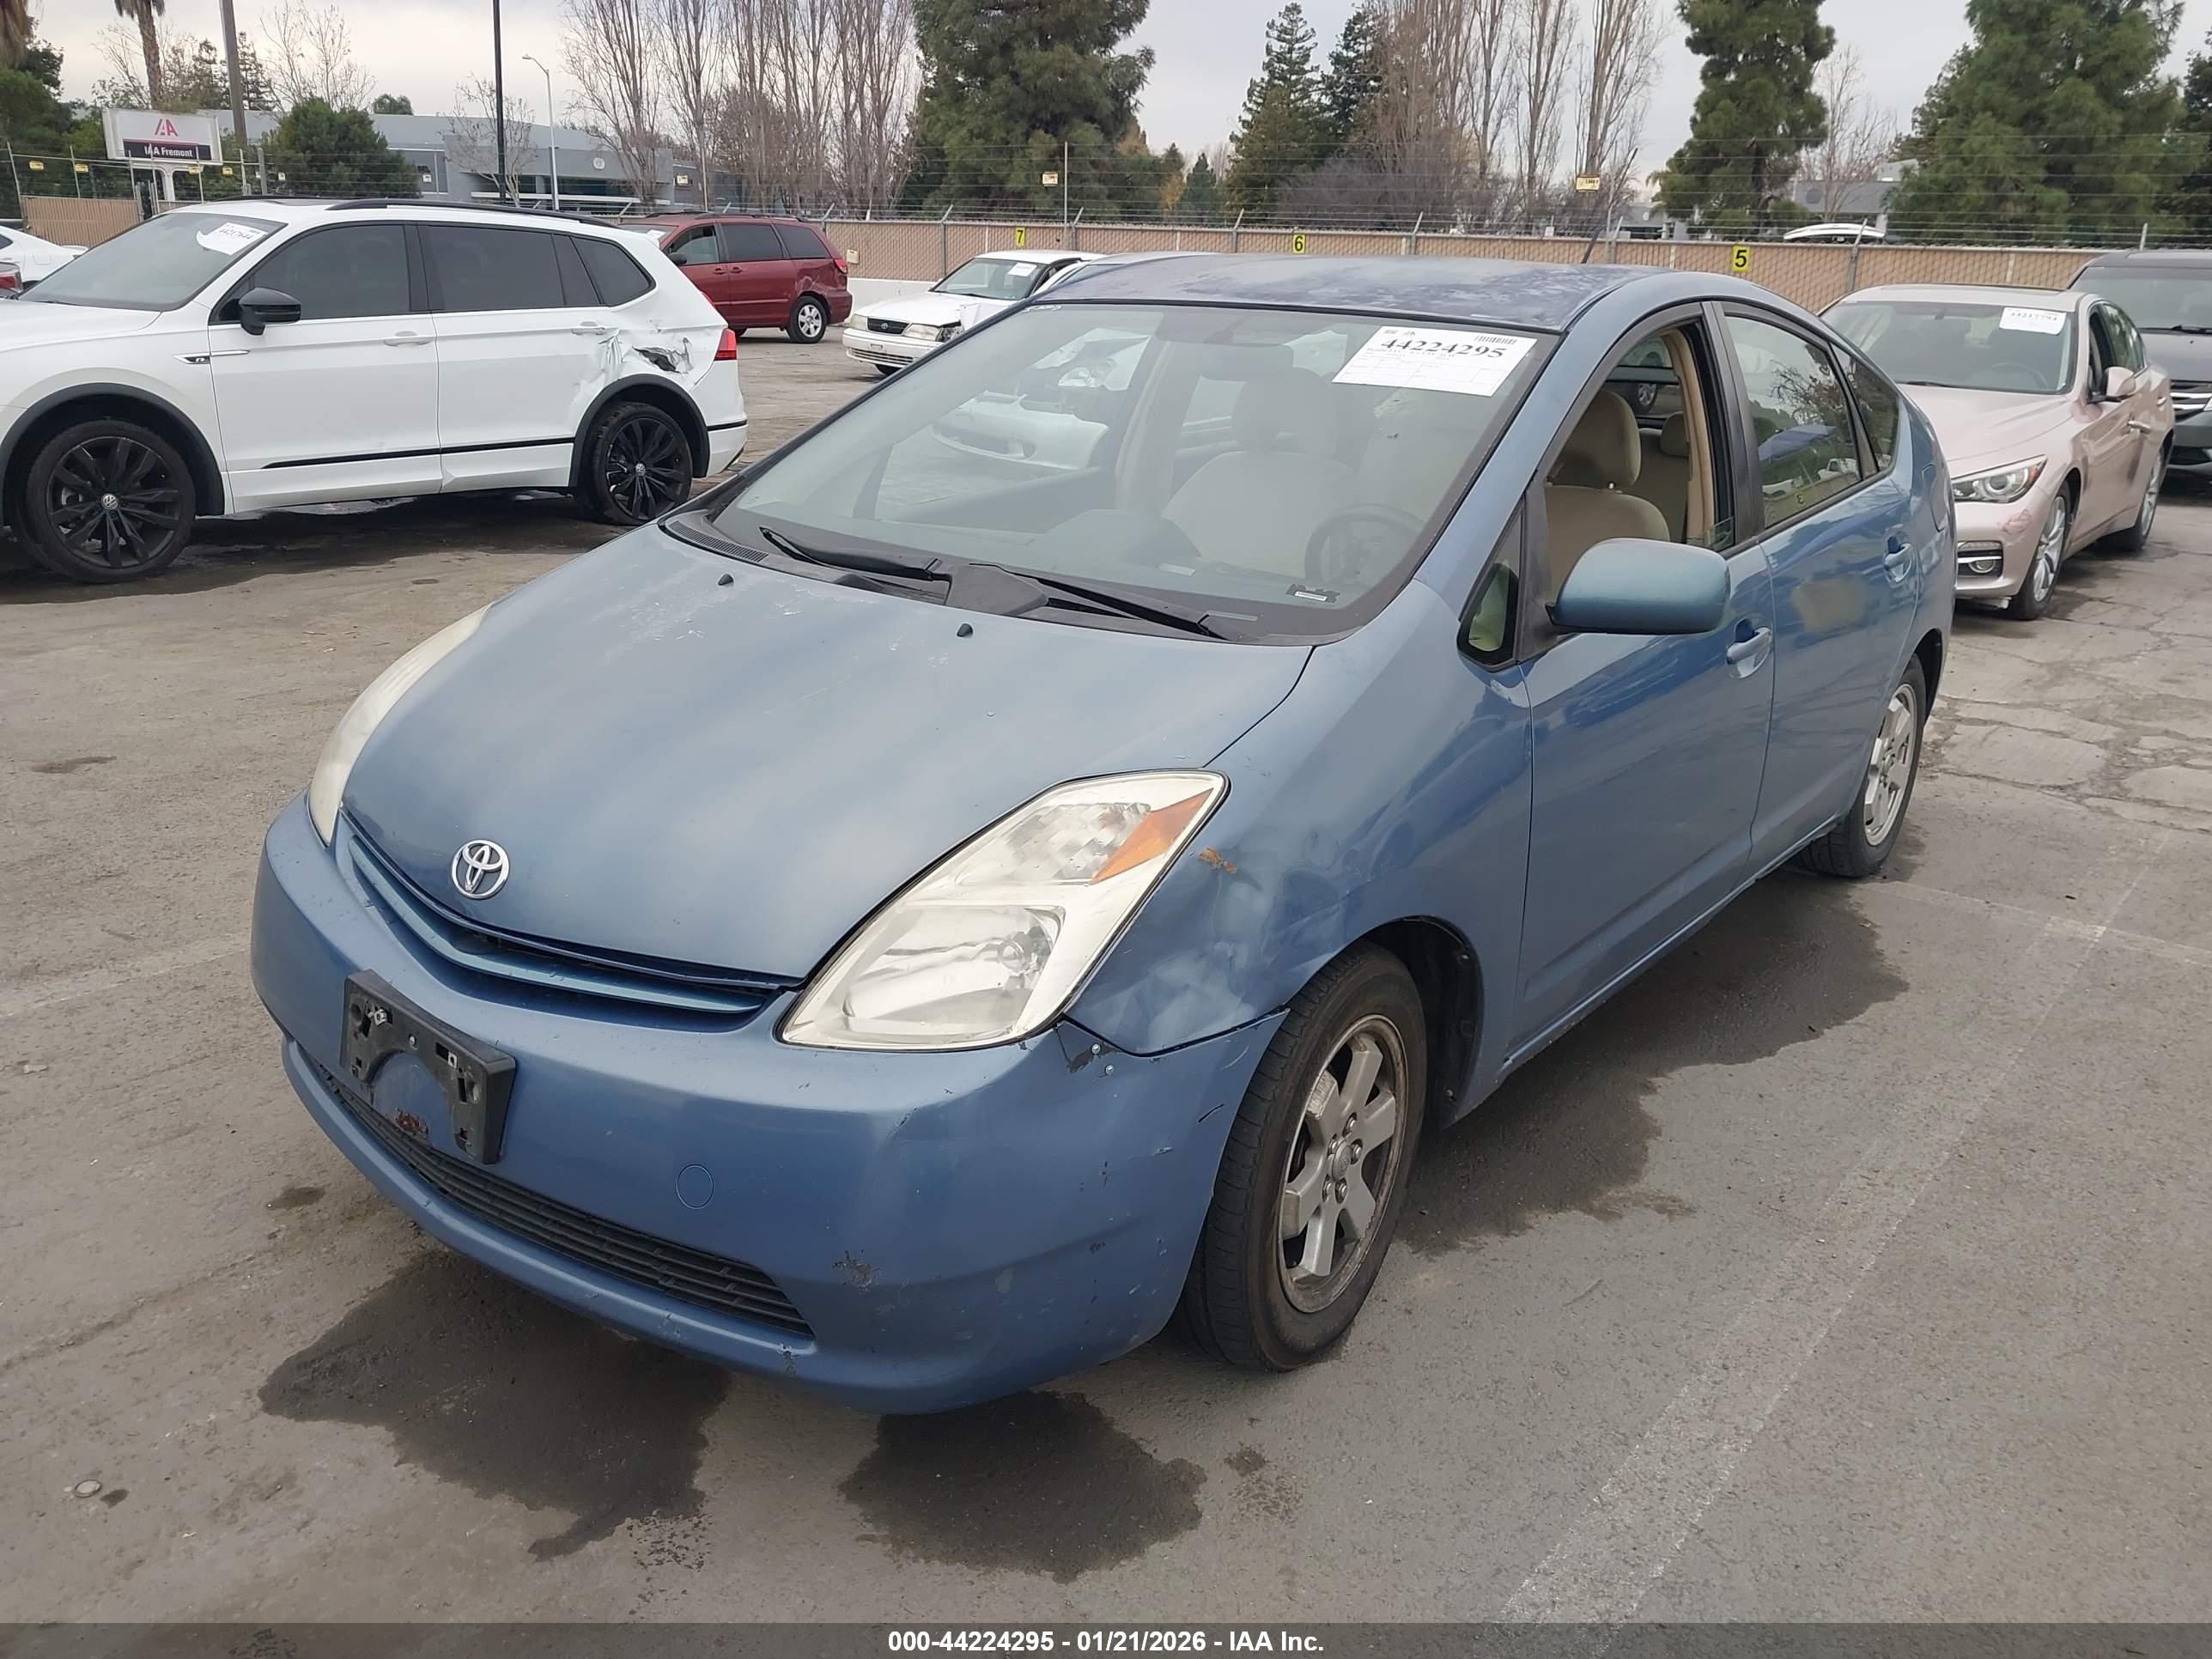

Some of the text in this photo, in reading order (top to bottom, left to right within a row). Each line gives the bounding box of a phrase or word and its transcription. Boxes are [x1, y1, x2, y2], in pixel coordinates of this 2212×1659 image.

[161, 147, 192, 157] Fremont
[1017, 229, 1024, 244] 7
[1294, 235, 1304, 252] 6
[1735, 249, 1747, 268] 5
[1381, 338, 1507, 358] 44224295
